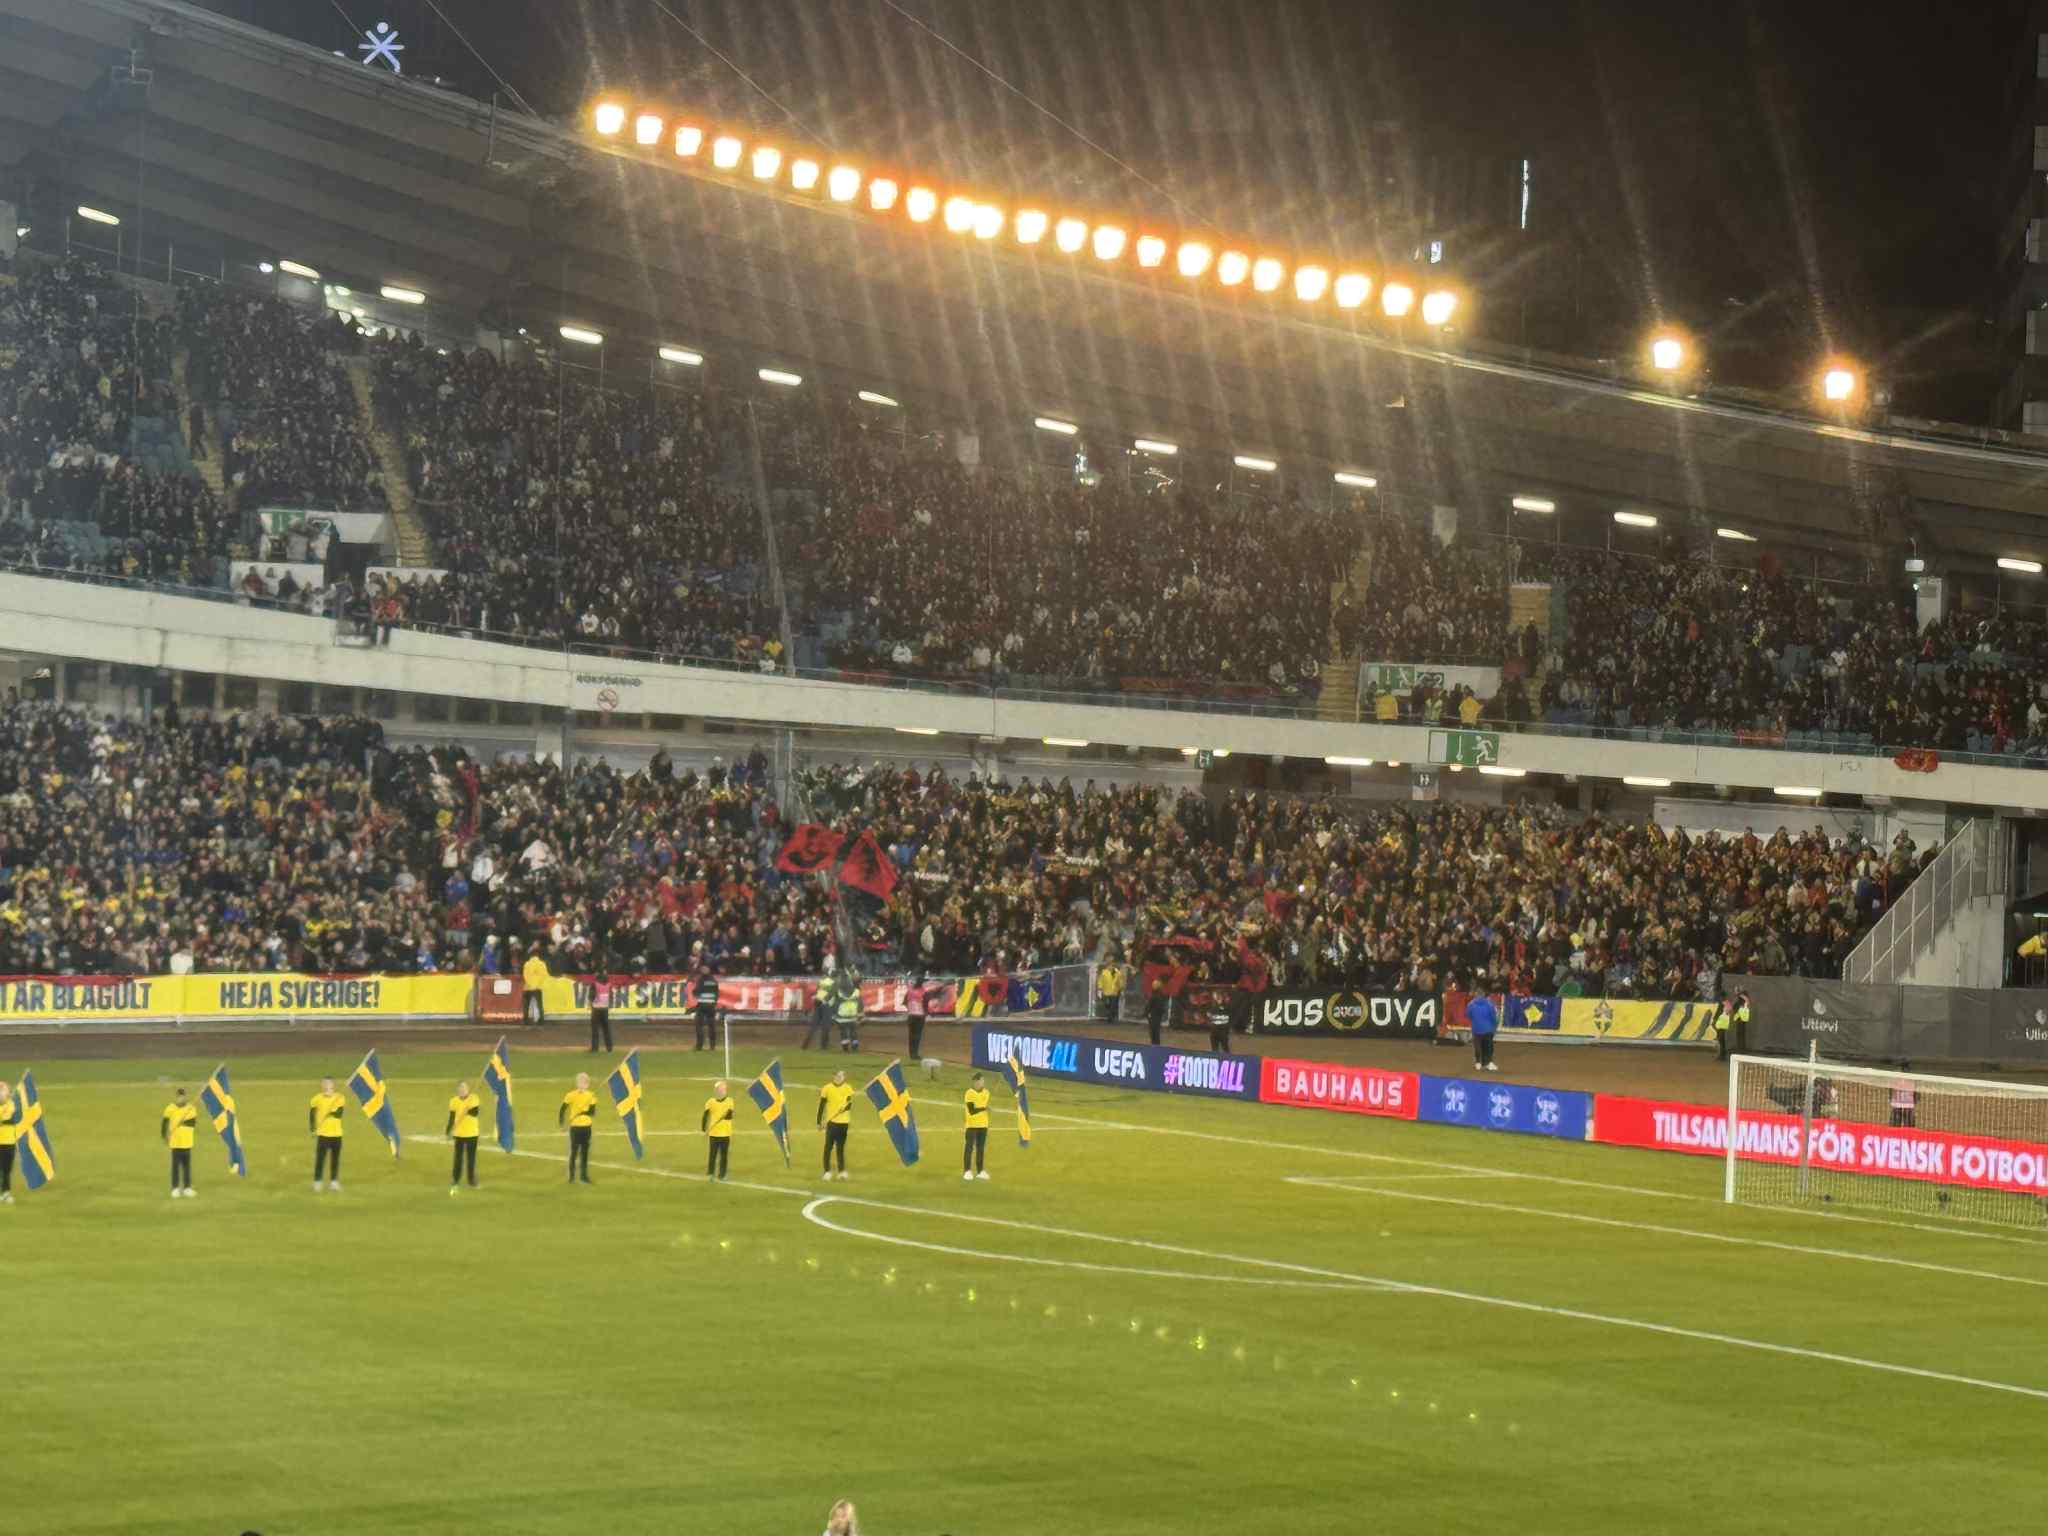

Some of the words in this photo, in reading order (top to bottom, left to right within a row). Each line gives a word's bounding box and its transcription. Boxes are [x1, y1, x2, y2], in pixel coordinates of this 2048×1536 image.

[221, 981, 273, 1008] HEJA
[279, 980, 380, 1008] SVERIGE!
[1094, 1047, 1146, 1079] UEFA
[1163, 1054, 1245, 1092] #FOOTBALL
[1276, 1068, 1404, 1106] BAUHAUS
[1807, 1124, 1856, 1164] FÖR
[1861, 1134, 1946, 1175] SVENSK
